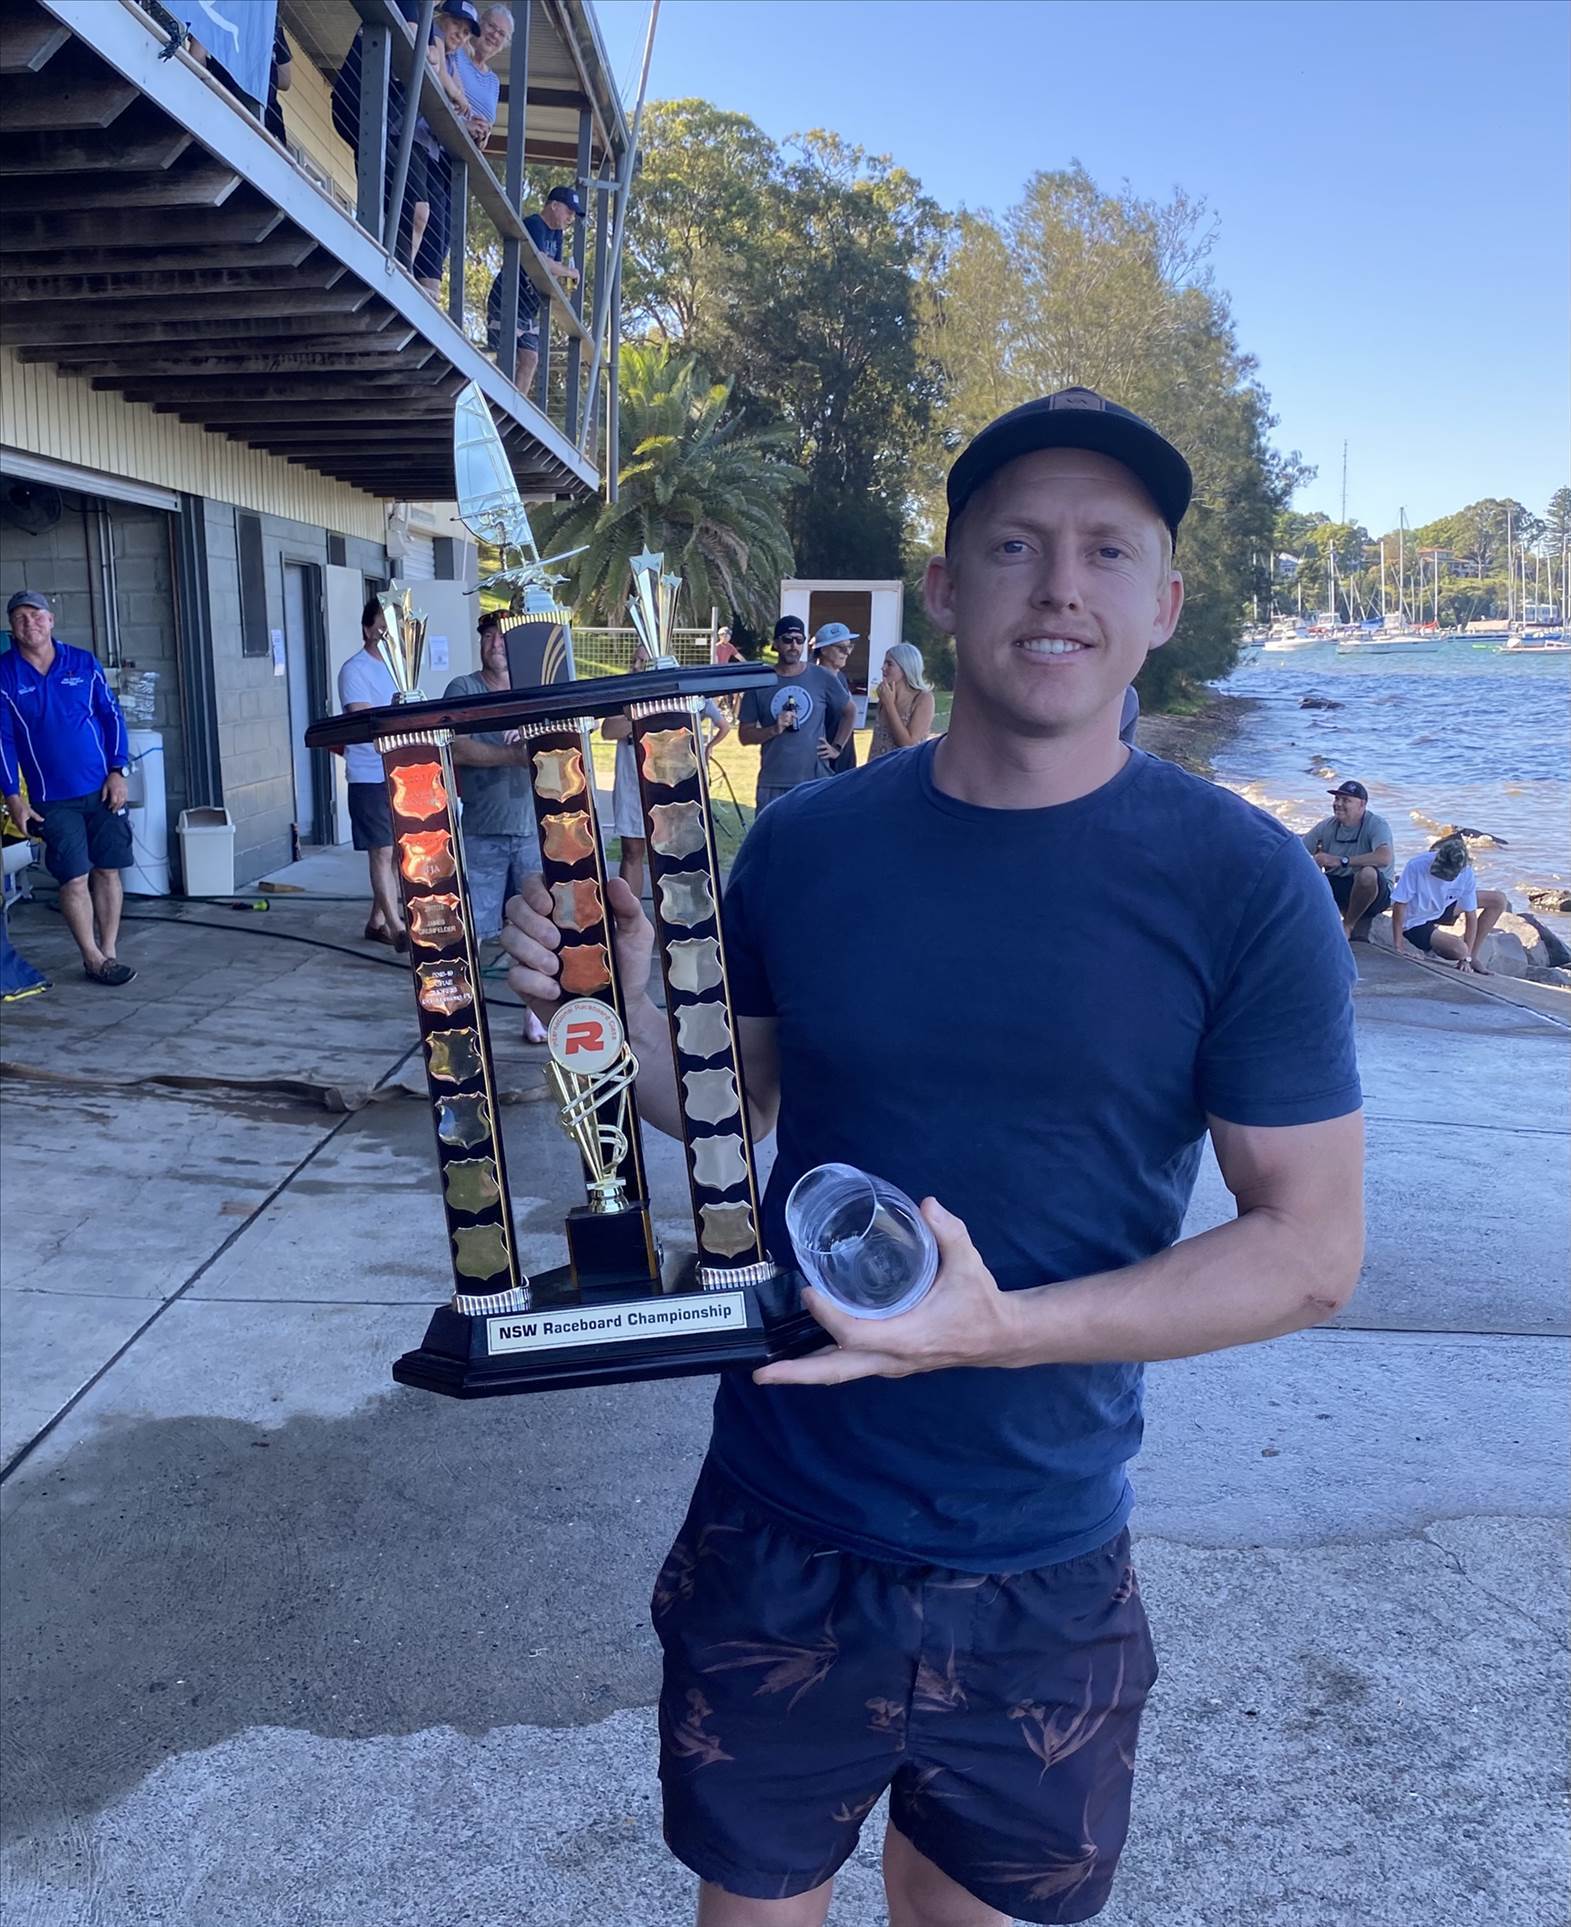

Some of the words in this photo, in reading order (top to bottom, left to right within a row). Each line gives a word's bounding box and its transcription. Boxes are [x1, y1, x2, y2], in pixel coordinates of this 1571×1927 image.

[566, 1021, 604, 1055] R
[499, 1323, 538, 1340] NSW
[543, 1315, 622, 1335] Raceboard
[628, 1304, 732, 1326] Championship
